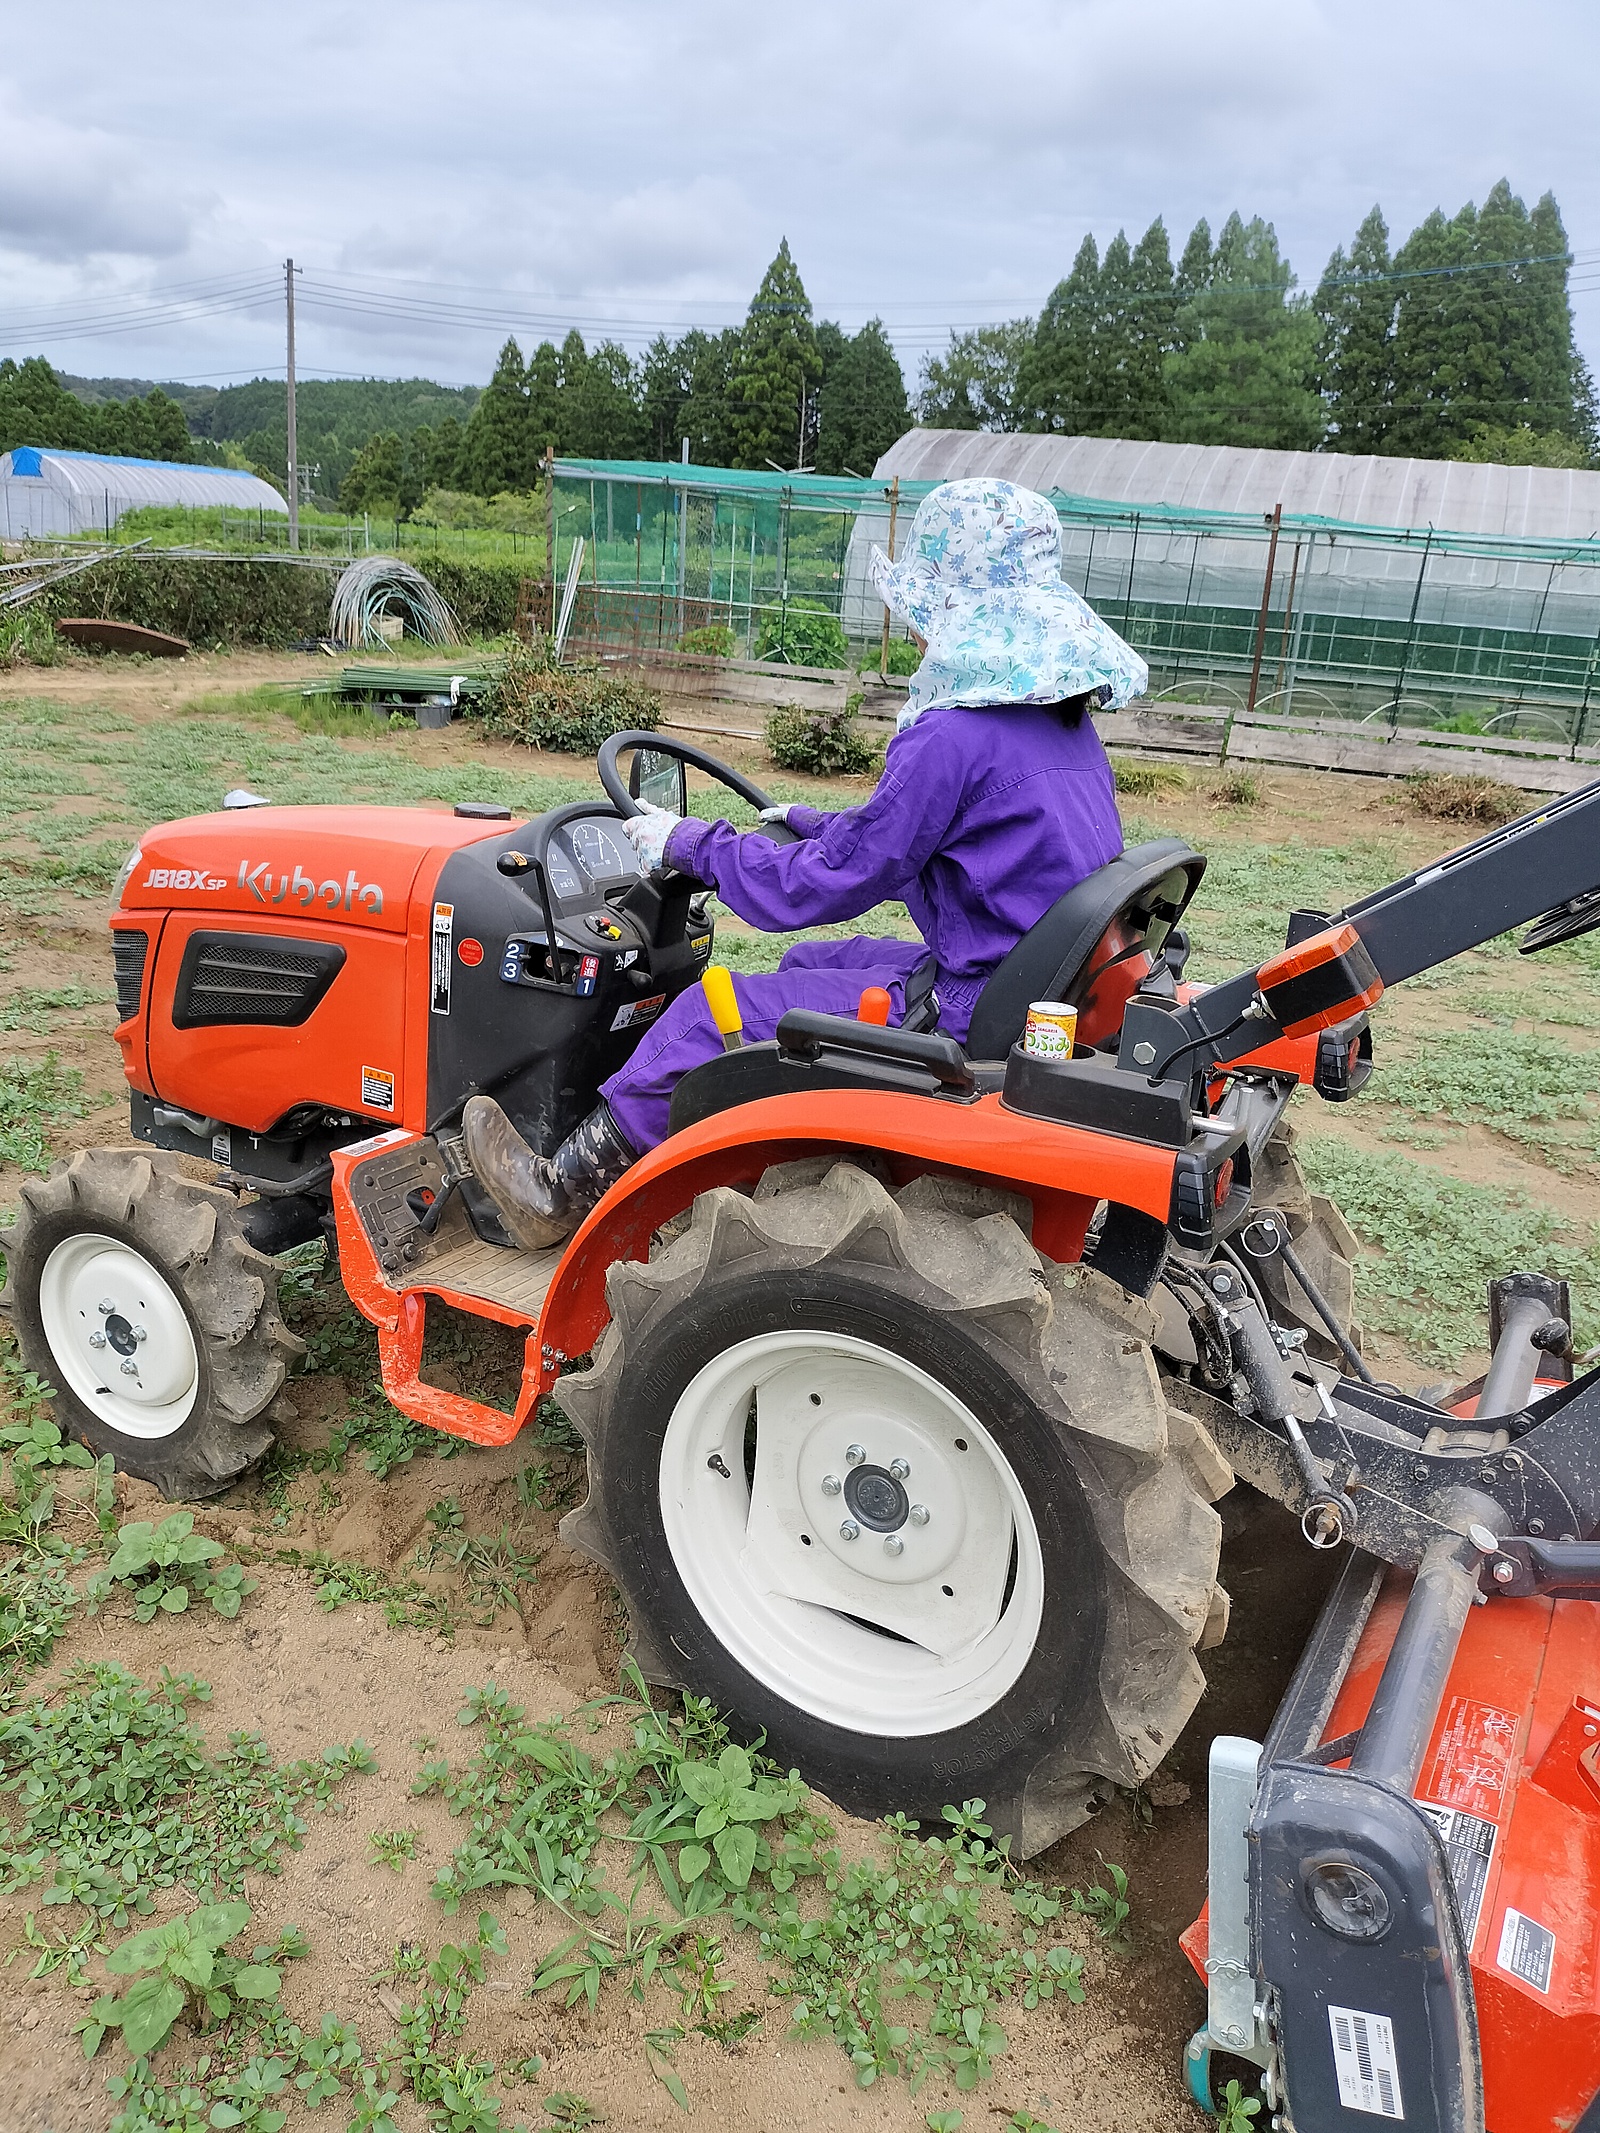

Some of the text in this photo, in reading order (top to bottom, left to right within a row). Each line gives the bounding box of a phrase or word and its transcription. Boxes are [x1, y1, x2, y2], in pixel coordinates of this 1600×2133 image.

[237, 859, 384, 915] Kubota
[505, 943, 520, 960] 2
[503, 962, 518, 979] 3
[583, 958, 597, 978] 後進
[583, 978, 591, 995] 1
[930, 1725, 1025, 1779] TRACTOR
